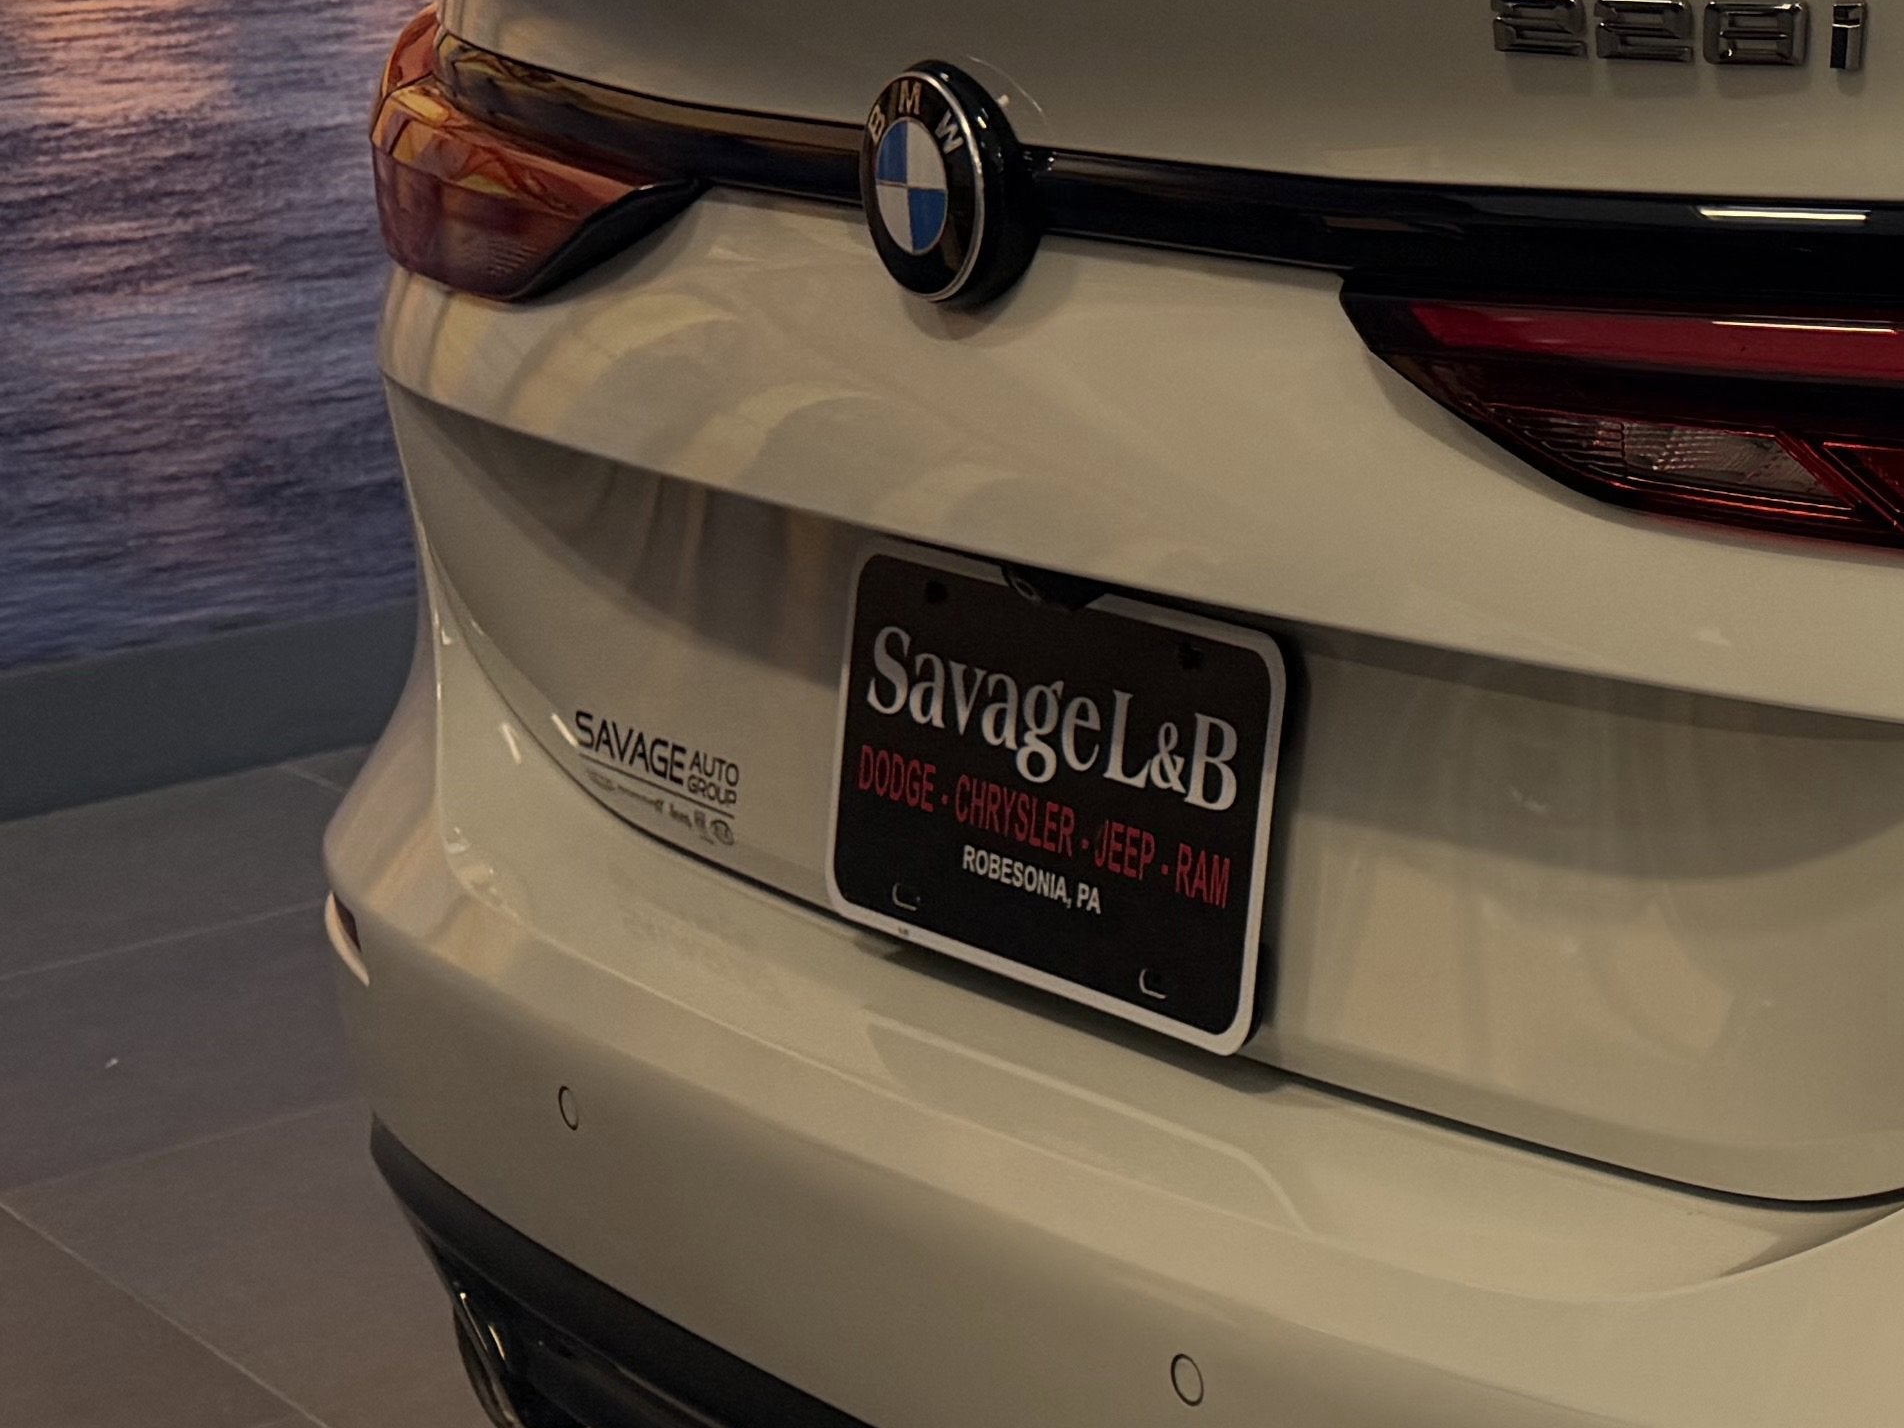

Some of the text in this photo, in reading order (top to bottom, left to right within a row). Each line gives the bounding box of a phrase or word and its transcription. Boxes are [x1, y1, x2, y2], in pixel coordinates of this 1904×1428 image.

[868, 79, 965, 155] BMW
[575, 710, 740, 787] SAVAGE AUTO
[687, 774, 738, 805] GROUP
[857, 744, 937, 812] DODGE
[954, 774, 1076, 858] CHRYSLER
[1094, 818, 1156, 881] JEEP
[1174, 842, 1231, 909] RAM
[962, 844, 1102, 914] ROBESONIA, PA
